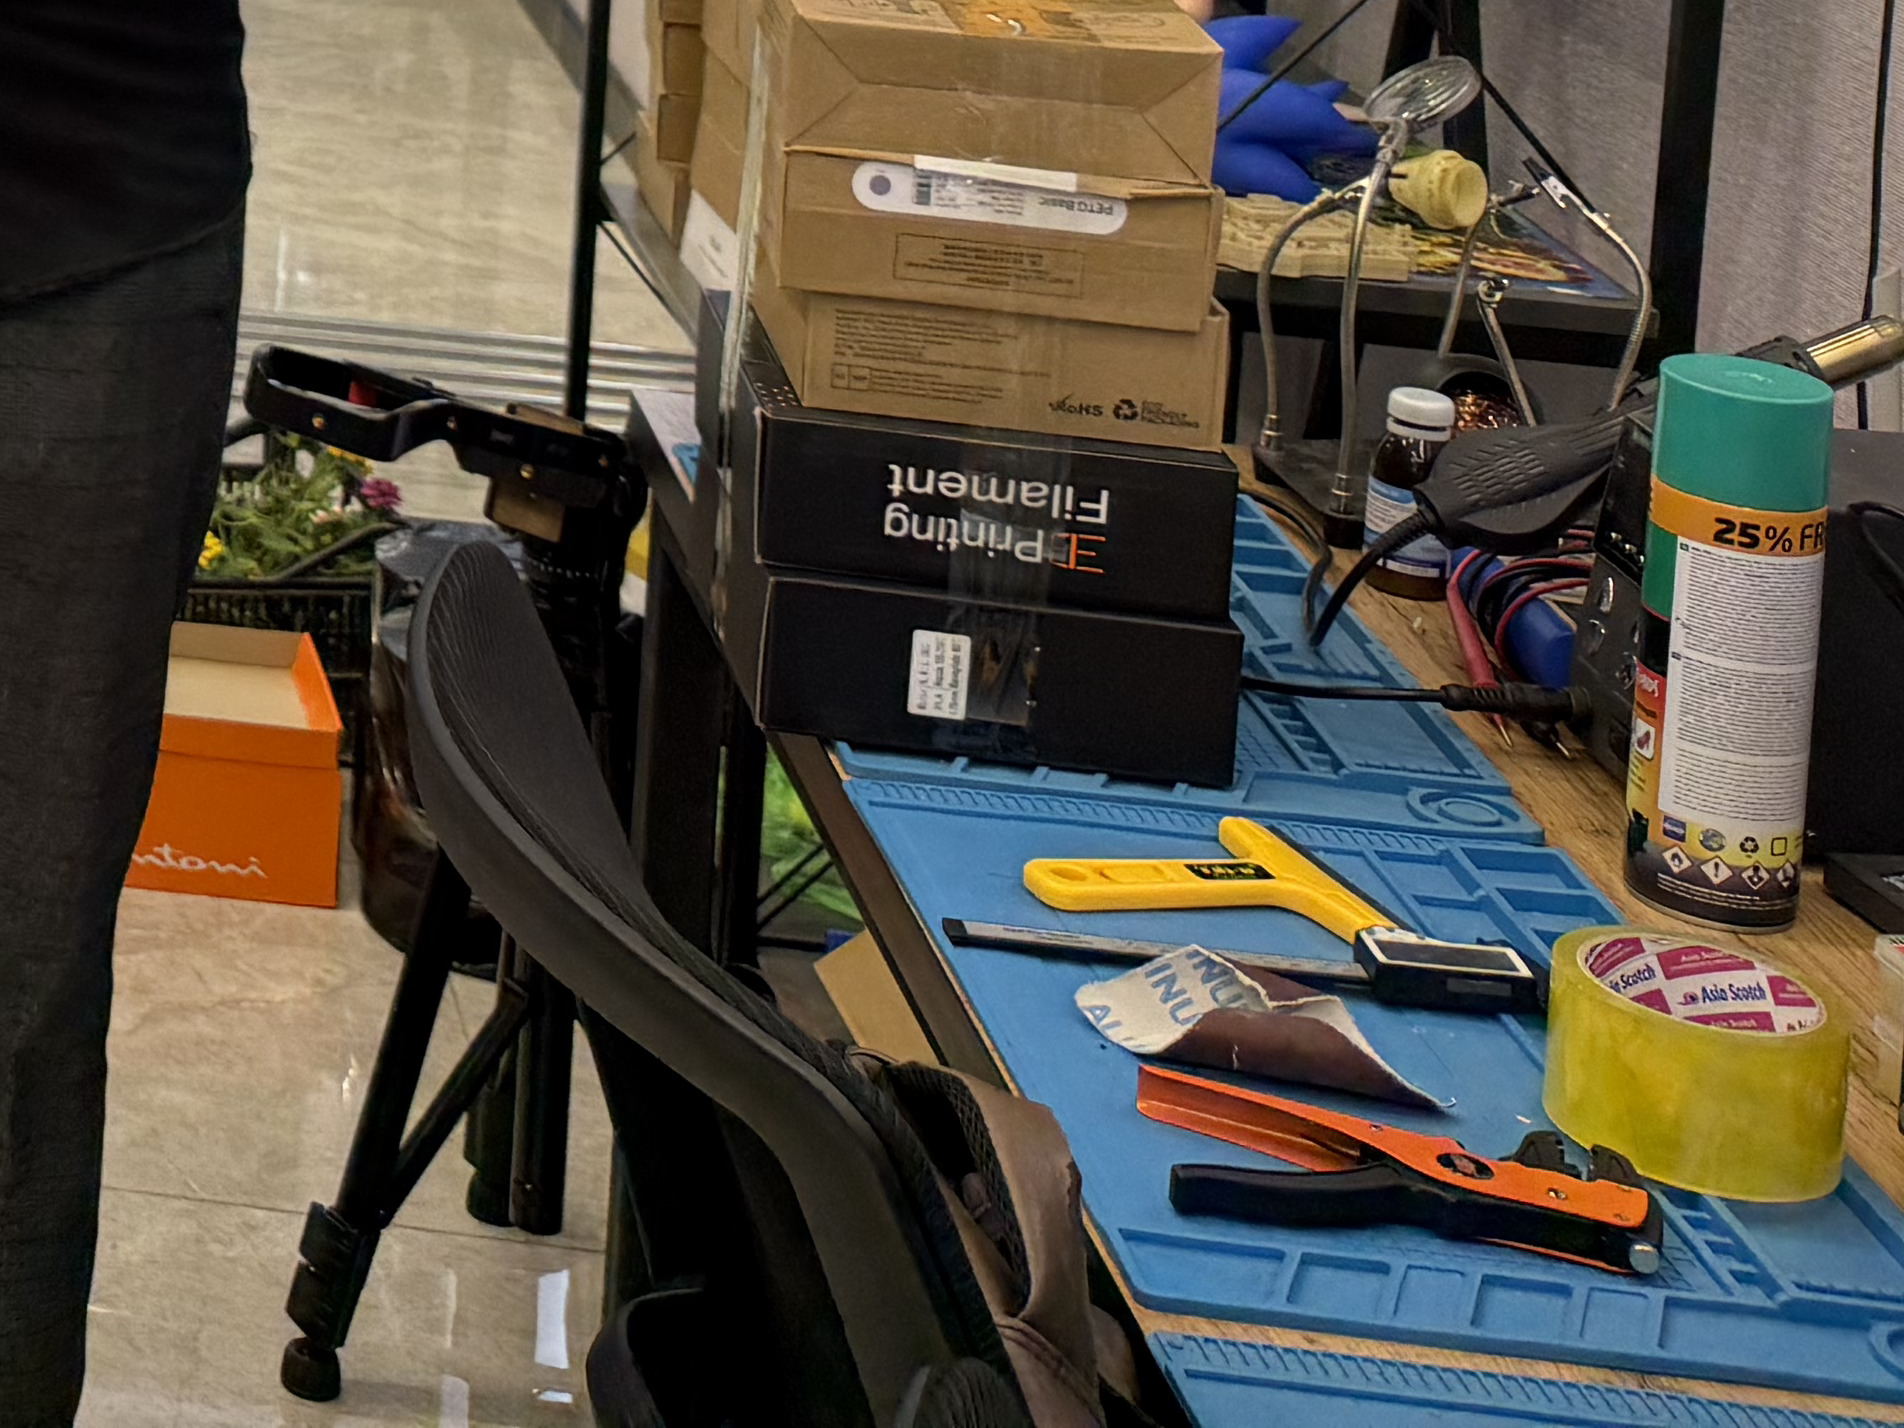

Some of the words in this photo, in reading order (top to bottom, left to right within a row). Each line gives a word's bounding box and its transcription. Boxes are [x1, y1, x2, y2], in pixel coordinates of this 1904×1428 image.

[886, 464, 1110, 524] Filament
[884, 502, 1045, 565] Printing
[1713, 517, 1792, 553] 25%
[1620, 963, 1657, 991] Scotch
[1701, 984, 1728, 1004] Asia
[1728, 981, 1767, 1002] Scotch
